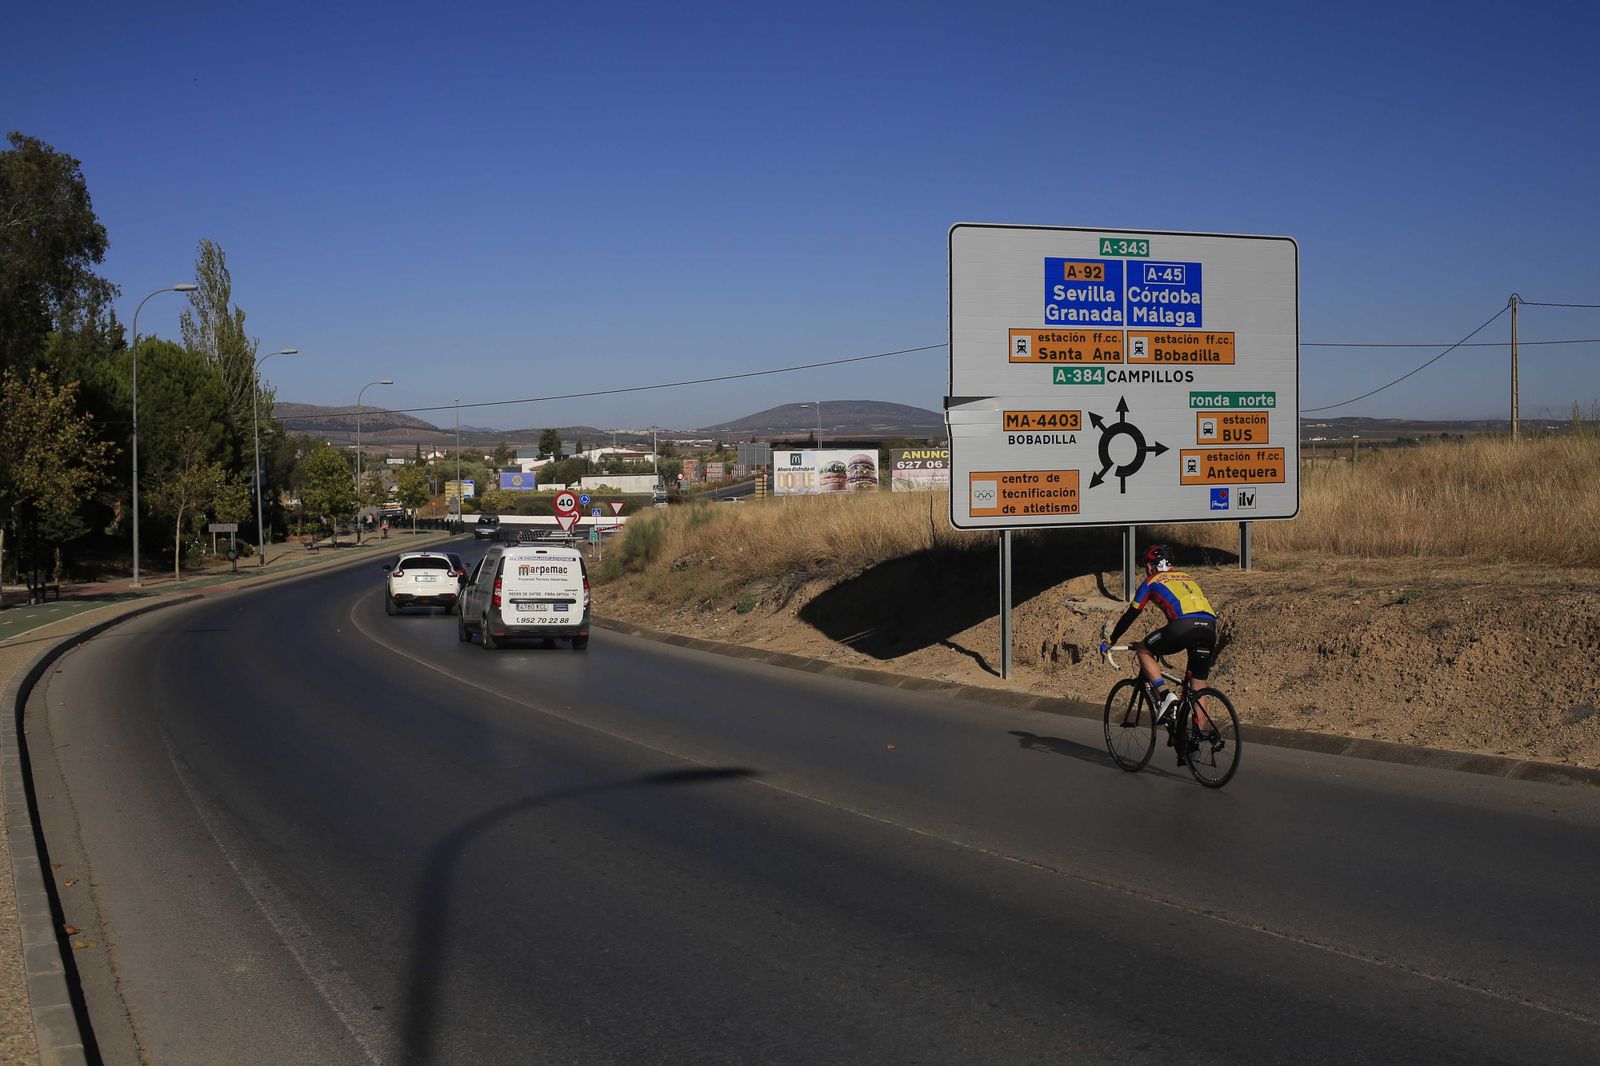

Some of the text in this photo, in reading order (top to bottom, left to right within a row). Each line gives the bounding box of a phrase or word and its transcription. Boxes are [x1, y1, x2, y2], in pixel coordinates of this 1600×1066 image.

[1102, 240, 1148, 255] A-343
[1067, 265, 1102, 280] A-92
[1147, 266, 1183, 281] A-45
[1053, 284, 1116, 303] Sevilla
[1127, 286, 1201, 305] Córdoba
[1045, 303, 1123, 323] Granada
[1132, 306, 1196, 327] Málaga
[1038, 332, 1121, 343] estación ff.cc.
[1154, 334, 1233, 345] estación ff.cc.
[1038, 347, 1121, 361] Santa Ana
[1154, 348, 1220, 362] Bobadilla
[1055, 368, 1103, 383] A-384
[1106, 369, 1194, 383] CAMPILLOS
[1190, 394, 1275, 406] ronda norte
[1006, 414, 1079, 428] MA-4403
[1222, 414, 1267, 425] estación
[1008, 434, 1077, 445] BOBADILLA
[1222, 429, 1253, 441] BUS
[902, 450, 950, 459] ANUNC
[1206, 451, 1283, 461] estación ff.cc.
[896, 461, 922, 469] 627
[926, 460, 943, 469] 06
[1002, 473, 1060, 484] centro de
[1207, 466, 1277, 480] Antequera
[1002, 488, 1076, 499] tecnificación
[558, 498, 574, 507] 40
[1002, 502, 1078, 514] de atletismo
